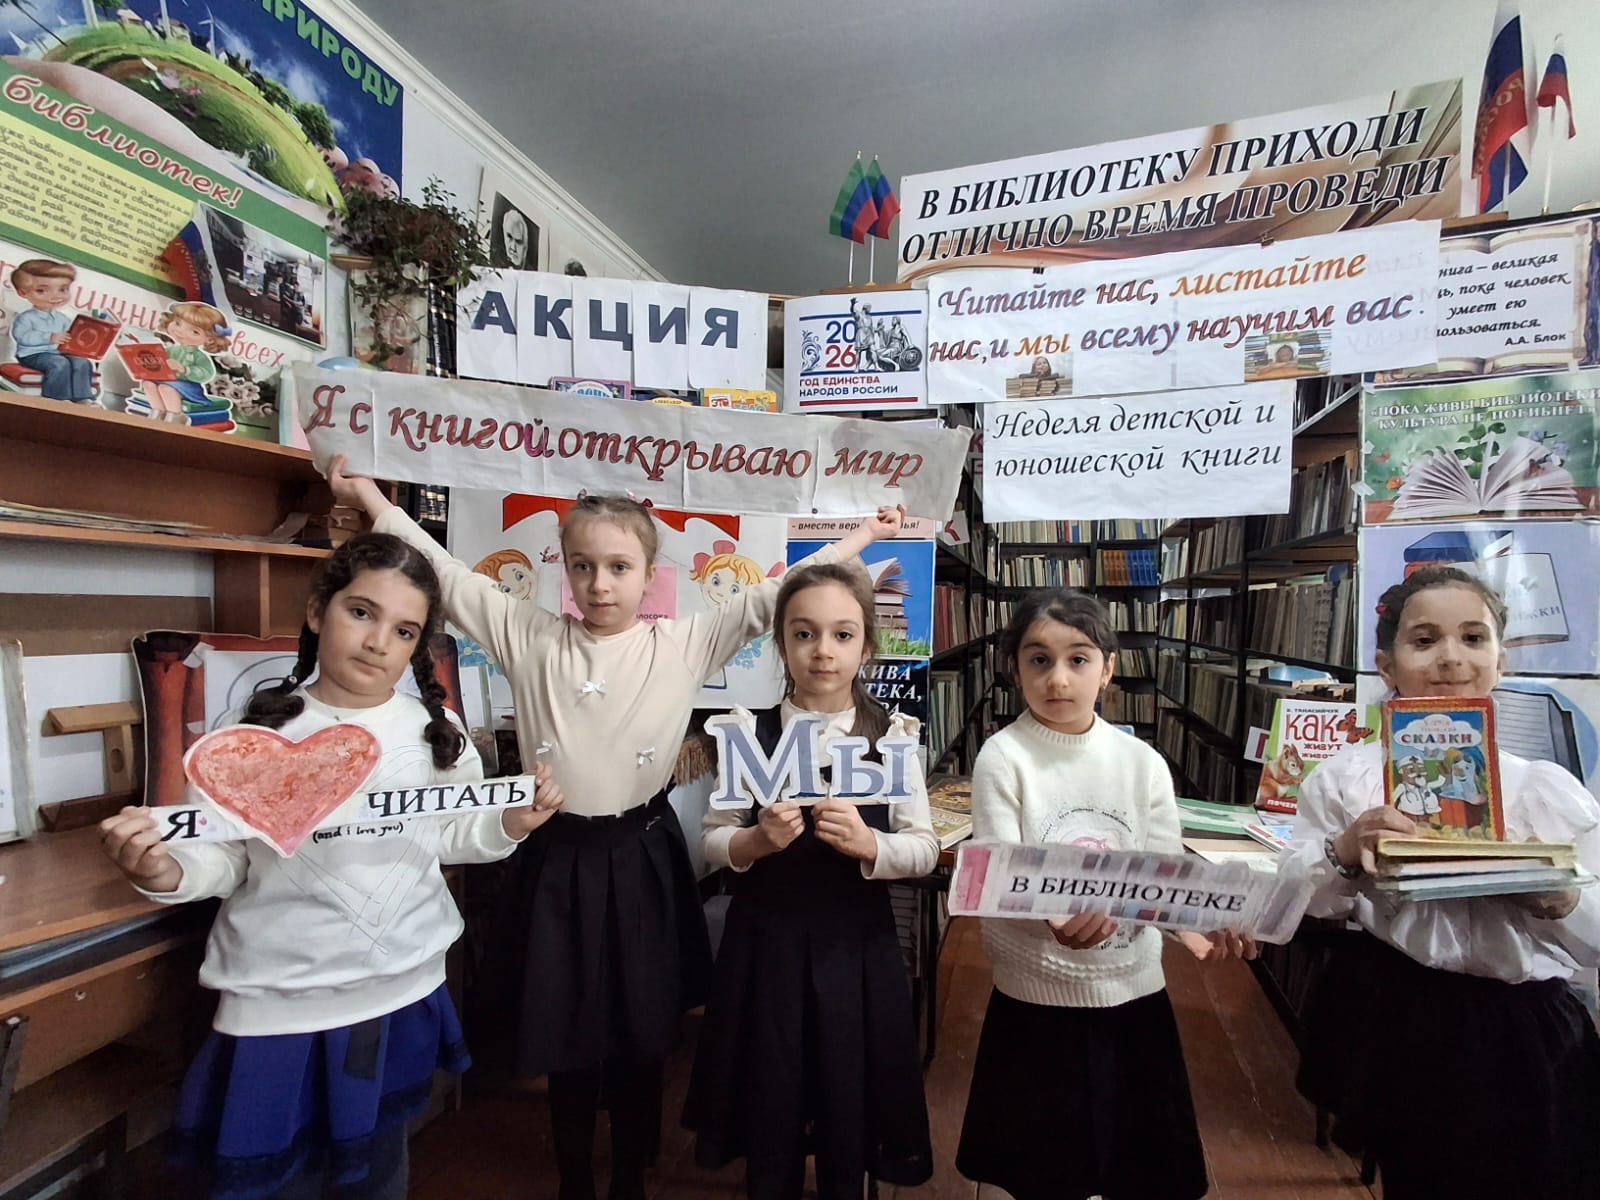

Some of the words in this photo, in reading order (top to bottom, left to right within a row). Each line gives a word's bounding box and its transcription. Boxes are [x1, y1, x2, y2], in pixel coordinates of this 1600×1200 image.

[5, 74, 243, 208] библиотек!
[68, 157, 81, 166] по
[917, 189, 940, 220] В
[947, 148, 1201, 216] БИБЛИОТЕКУ
[1207, 107, 1429, 177] ПРИХОДИ
[81, 173, 95, 182] по
[902, 214, 1073, 264] ОТЛИЧНО
[1081, 192, 1222, 243] ВРЕМЯ
[1226, 156, 1452, 223] ПРОВЕДИ
[1438, 265, 1473, 279] нига
[1491, 253, 1558, 271] великая
[938, 283, 1087, 316] Читайте
[1096, 278, 1159, 305] нас,
[1169, 253, 1367, 297] листайте
[1459, 282, 1495, 295] пока
[1504, 273, 1572, 290] человек
[471, 290, 739, 351] АКЦИЯ
[1446, 303, 1497, 320] умеет
[1505, 299, 1527, 310] ею
[826, 320, 858, 343] 20
[1014, 333, 1071, 357] мы
[1080, 320, 1179, 355] всему
[1187, 305, 1335, 348] научим
[1505, 336, 1530, 346] А.А.
[1534, 333, 1567, 344] Блок
[231, 330, 285, 367] всех
[825, 345, 857, 368] 26
[800, 378, 819, 387] ГОД
[823, 376, 880, 386] ЕДИНСТВА
[800, 386, 849, 396] НАРОДОВ
[852, 385, 898, 395] РОССИИ
[1424, 400, 1474, 413] ЖИВЫ
[992, 408, 1101, 439] Неделя
[1109, 400, 1242, 434] детской
[1255, 403, 1277, 424] и
[1379, 415, 1458, 429] КУЛЬТУРА
[1463, 413, 1484, 423] НЕ
[304, 384, 345, 434] Я
[349, 402, 372, 434] с
[824, 446, 923, 488] мир
[995, 445, 1165, 477] юношеской
[1181, 445, 1281, 475] книги
[798, 522, 836, 530] вместе
[1303, 743, 1342, 751] ЖИВУТ
[1401, 733, 1472, 744] СКАЗКИ
[712, 718, 912, 802] Мы
[161, 810, 201, 842] Я
[367, 782, 527, 818] ЧИТАТЬ
[1011, 876, 1030, 893] В
[1039, 877, 1247, 912] БИБЛИОТЕКЕ
